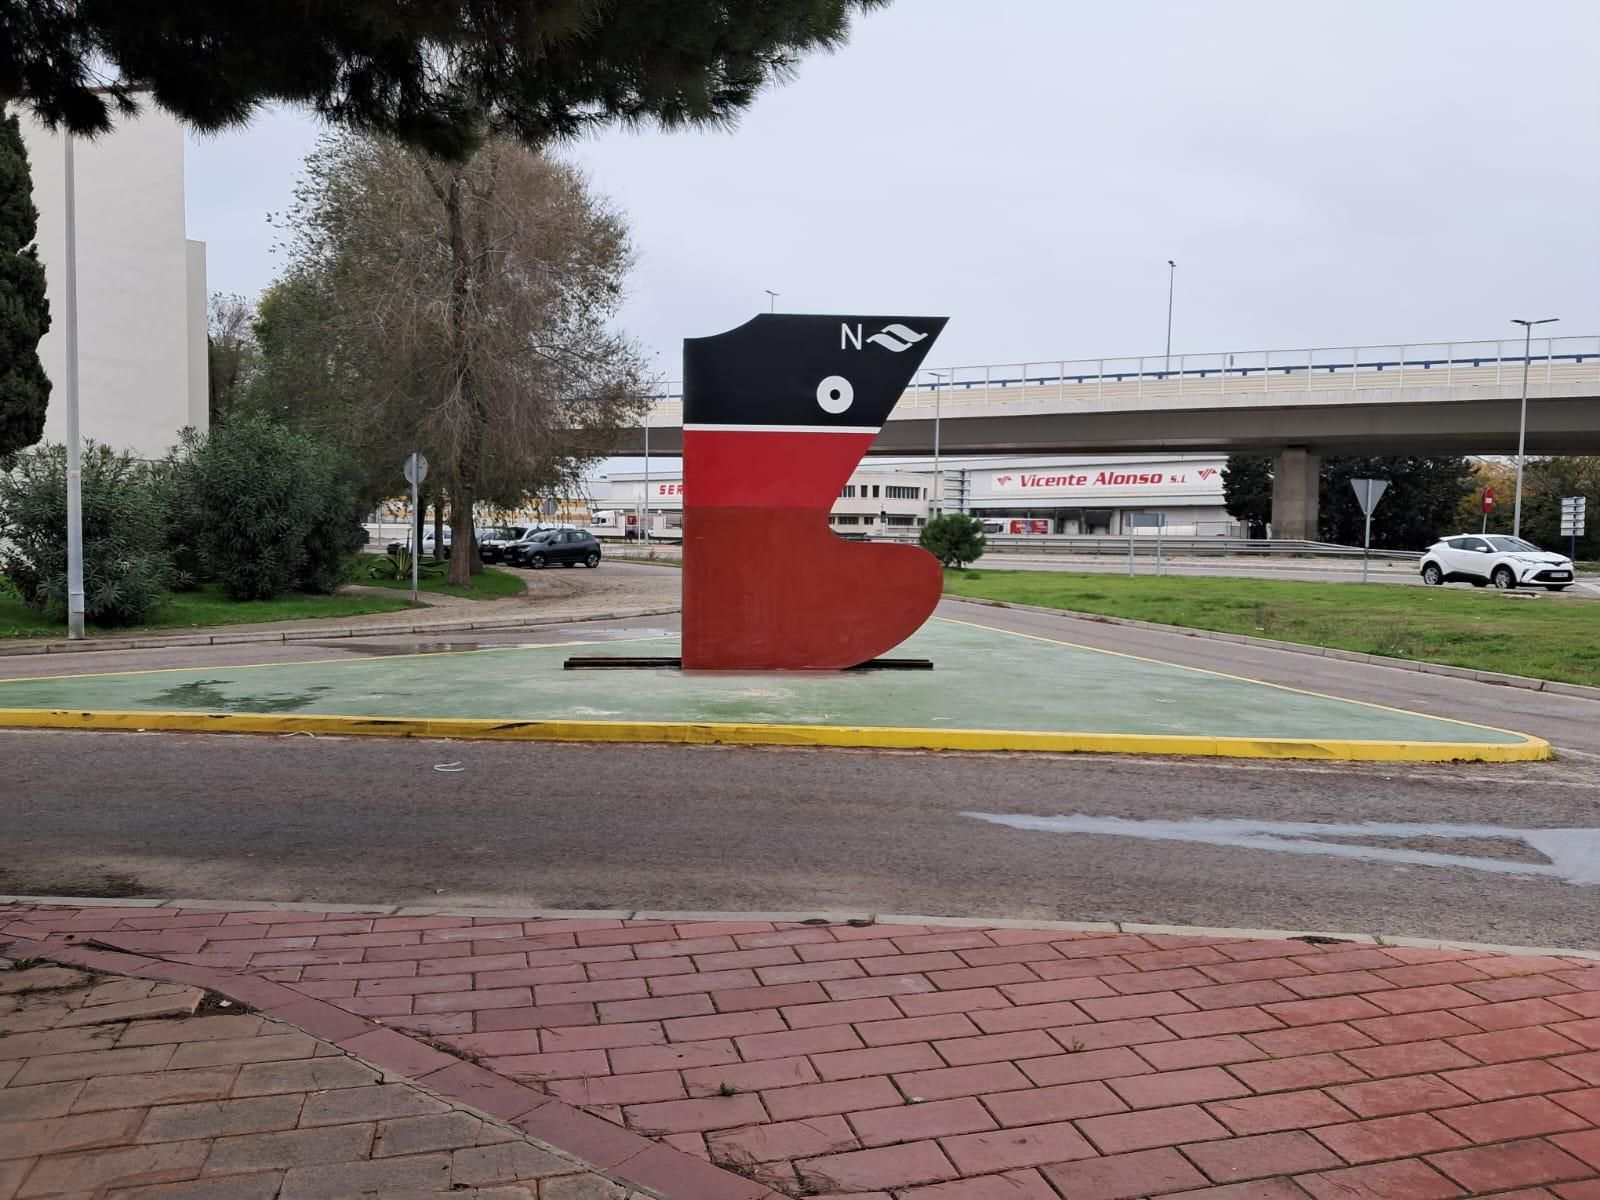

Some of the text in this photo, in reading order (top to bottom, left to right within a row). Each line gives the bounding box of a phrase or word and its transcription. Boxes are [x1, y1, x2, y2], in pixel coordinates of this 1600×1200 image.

[841, 323, 862, 350] N
[1021, 474, 1087, 487] Vicente
[1093, 472, 1163, 485] Alonso
